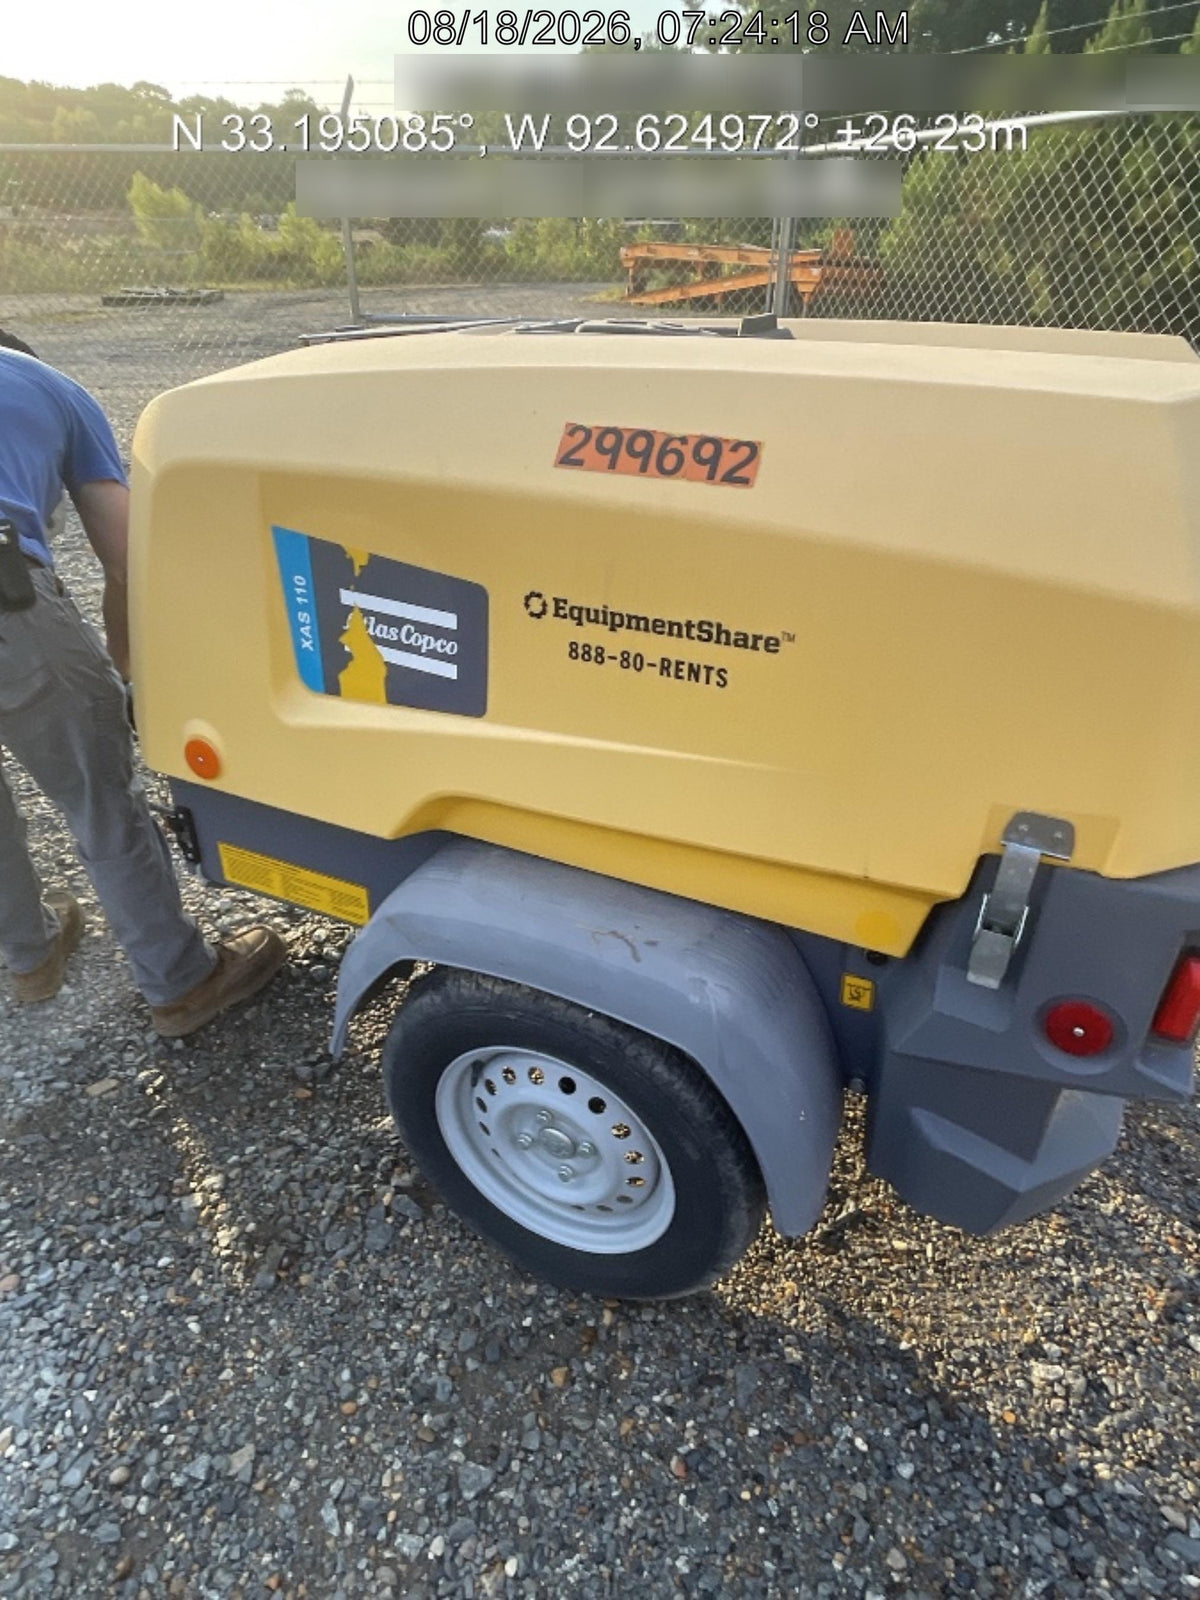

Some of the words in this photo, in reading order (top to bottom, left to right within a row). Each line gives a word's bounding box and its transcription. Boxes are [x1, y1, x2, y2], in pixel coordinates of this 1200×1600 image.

[558, 424, 759, 485] 299692
[293, 575, 309, 604] 110
[297, 614, 315, 651] XAS
[568, 641, 729, 688] 888-80-RENTS
